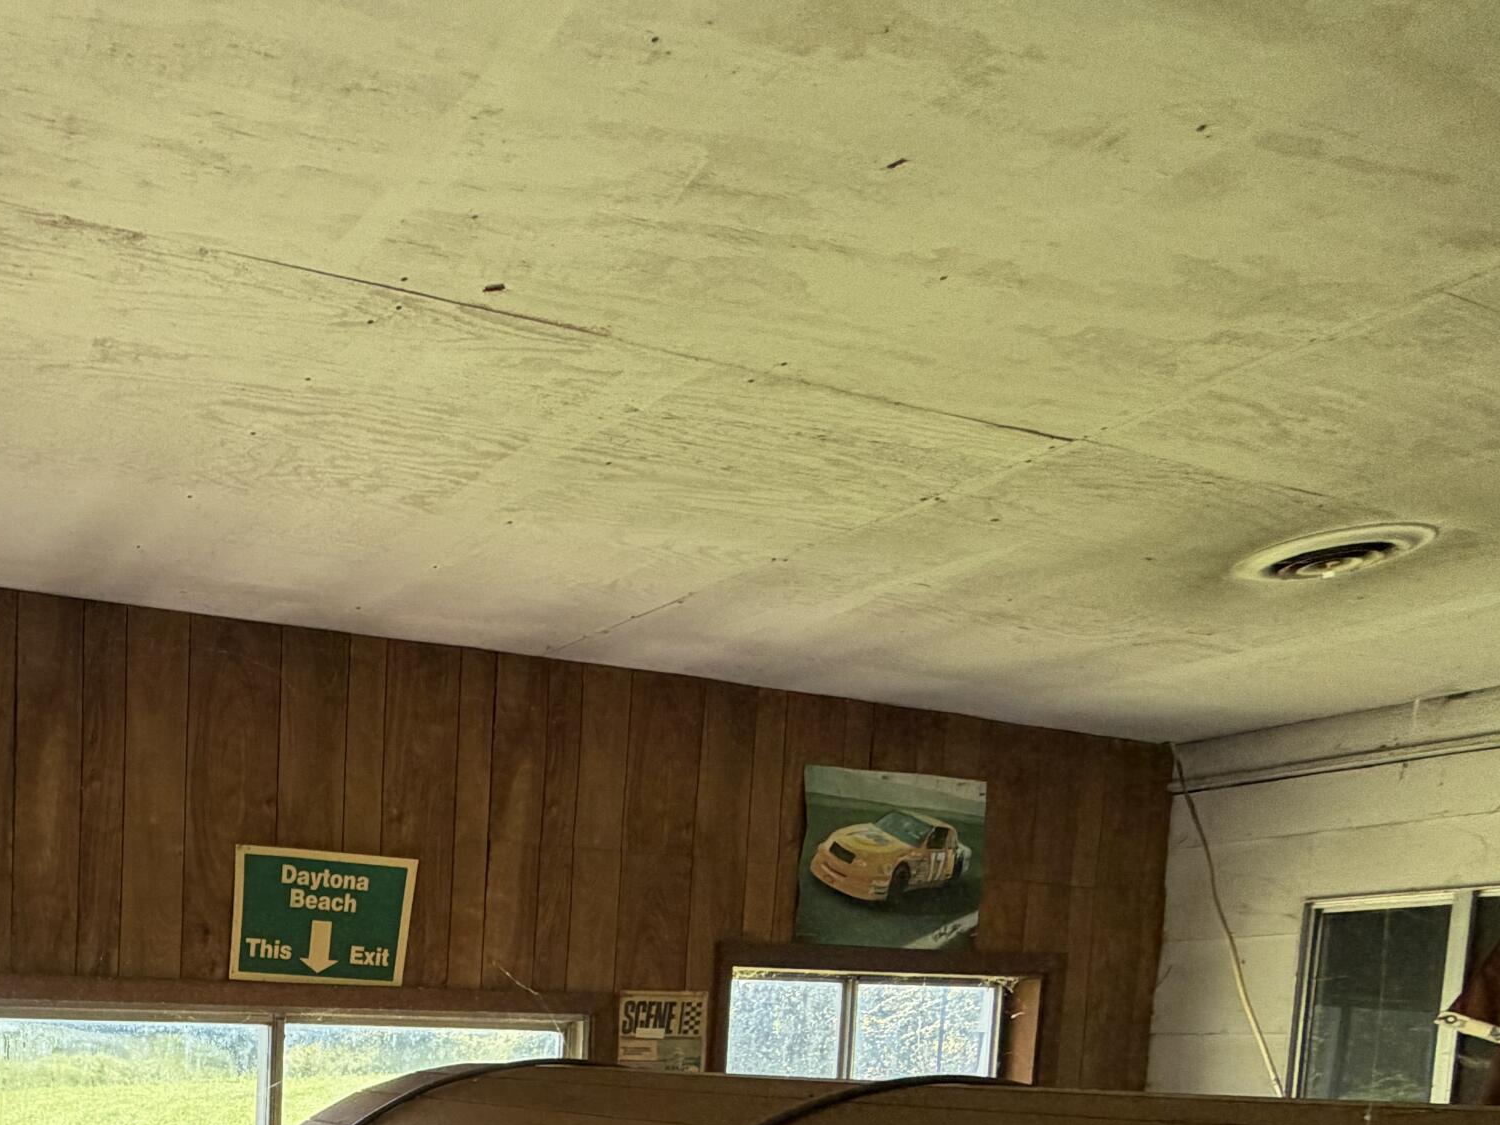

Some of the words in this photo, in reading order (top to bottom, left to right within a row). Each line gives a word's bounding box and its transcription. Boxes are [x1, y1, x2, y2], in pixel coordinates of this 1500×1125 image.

[281, 864, 370, 892] Daytona
[289, 888, 357, 913] Beach
[245, 937, 293, 961] This
[349, 945, 390, 968] Exit
[621, 1000, 678, 1035] SCENE
